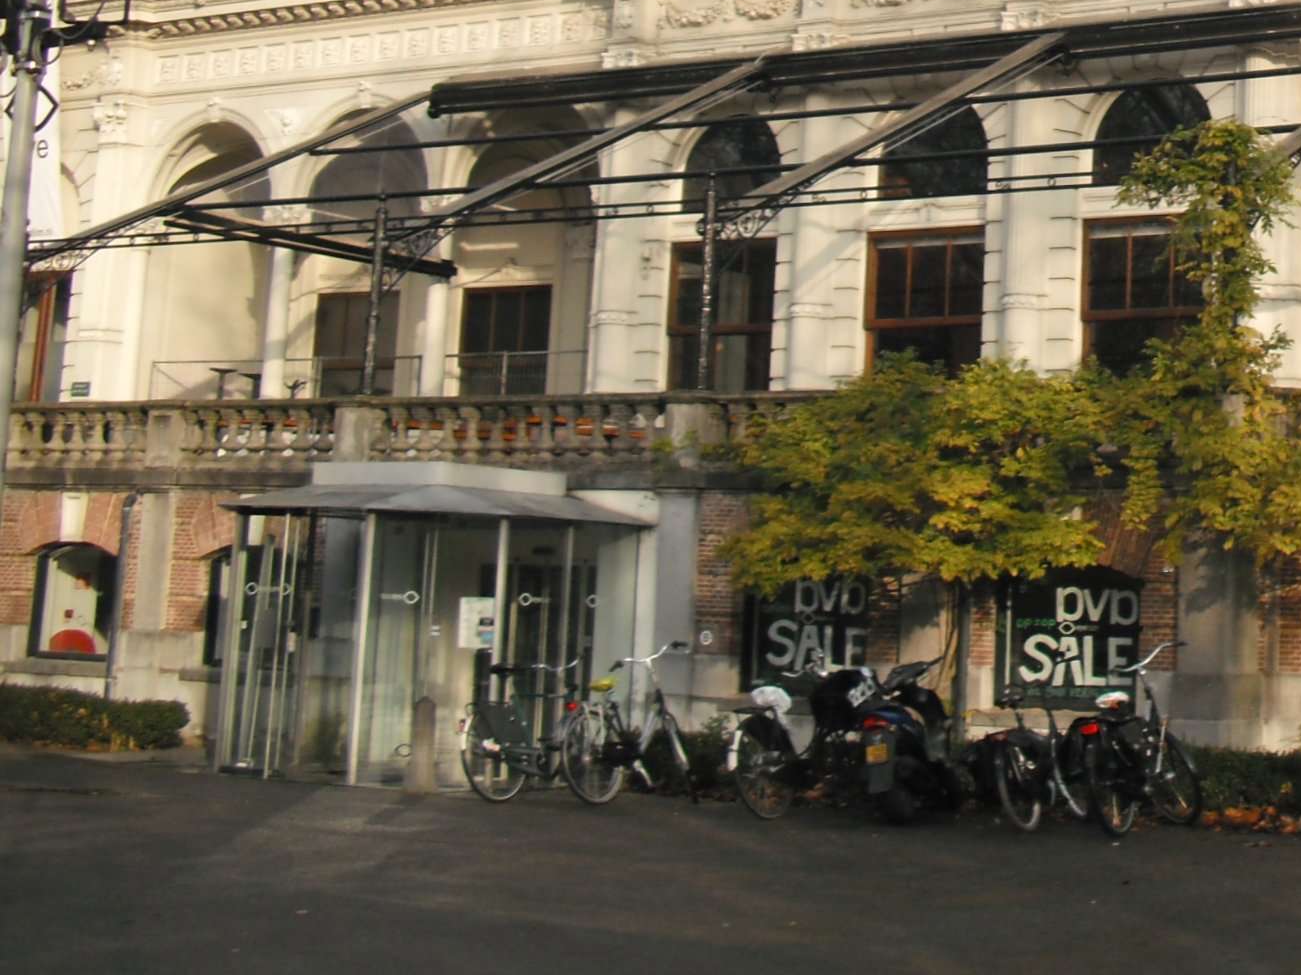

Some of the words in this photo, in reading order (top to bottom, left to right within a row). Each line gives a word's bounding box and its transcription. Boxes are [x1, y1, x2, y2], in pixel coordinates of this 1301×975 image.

[794, 580, 867, 614] DVD
[1056, 586, 1139, 626] DVD
[765, 619, 868, 673] SALE
[1019, 633, 1134, 686] SALE
